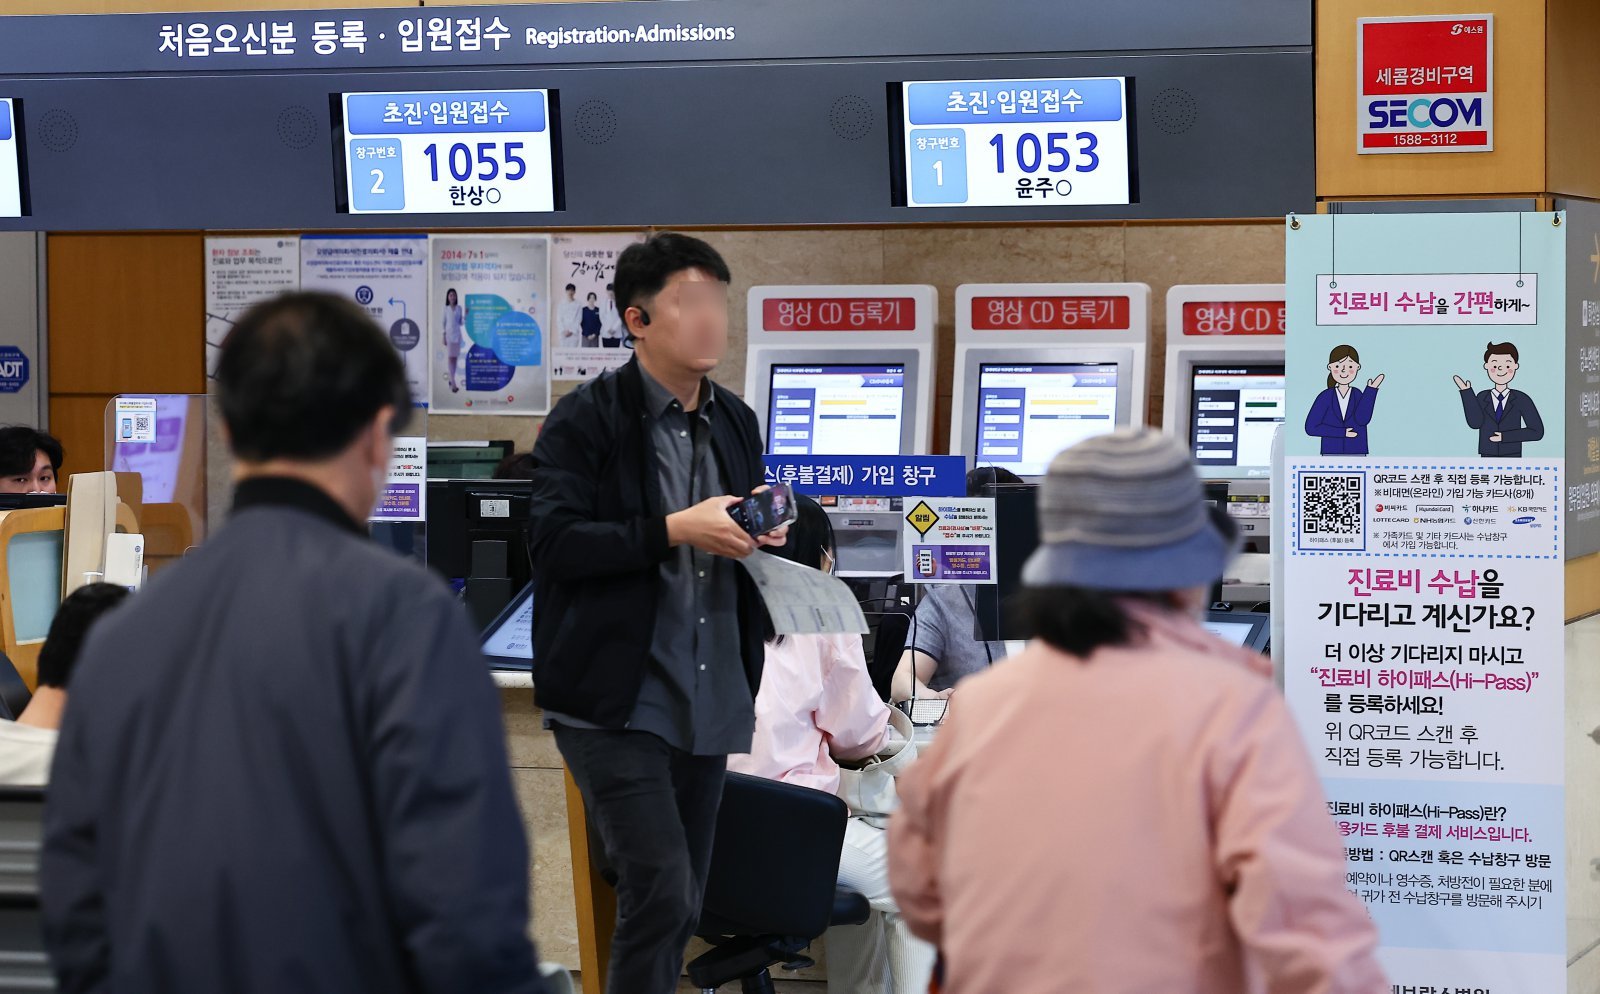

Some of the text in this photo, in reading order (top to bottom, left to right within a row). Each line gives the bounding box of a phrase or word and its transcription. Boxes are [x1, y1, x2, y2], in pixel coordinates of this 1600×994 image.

[158, 22, 297, 57] 처음오신분
[311, 20, 368, 55] 등록
[398, 16, 512, 53] 입원접수
[1375, 65, 1474, 86] 세콤경비구역
[383, 99, 510, 126] 초진·입원접수
[946, 88, 1084, 115] 초진·입원접수
[1368, 97, 1482, 129] SECOM
[915, 136, 961, 150] 창구번호
[1393, 133, 1458, 145] 1588-3112
[355, 145, 397, 160] 창구번호
[424, 141, 527, 182] 1055
[989, 131, 1100, 174] 1053
[369, 168, 385, 194] 2
[931, 159, 944, 187] 1
[777, 301, 901, 326] 영상 CD 등록기
[987, 300, 1115, 325] 영상 CD 등록기
[1329, 291, 1530, 316] 진료비 수납을 간편하게~
[1195, 307, 1236, 333] 영상
[1240, 308, 1271, 331] CD
[861, 464, 895, 485] 가입
[902, 464, 937, 486] 창구
[1373, 474, 1545, 486] QR코드 스캔 후 직접 등록 가능합니다.
[1446, 488, 1464, 499] 가입
[1466, 488, 1484, 499] 가능
[1485, 488, 1534, 500] 카드사(8개)
[915, 514, 930, 522] 알림
[1382, 540, 1459, 550] 에서 가입 가능합니다.
[1416, 531, 1424, 541] 및
[1426, 531, 1441, 540] 기타
[1444, 531, 1474, 541] 카드사는
[1476, 532, 1507, 541] 수납창구
[1348, 568, 1504, 599] 진료비 수납을
[1318, 601, 1536, 633] 기다리고 계신가요?
[1325, 643, 1525, 666] 더 이상 기다리지 마시고
[1324, 693, 1443, 716] 를 등록하세요!
[1325, 721, 1479, 745] 위 QR코드 스캔 후
[1325, 746, 1505, 771] 직접 등록 가능합니다.
[1335, 820, 1533, 843] 용카드 후불 결제 서비스입니다.
[1344, 847, 1374, 862] 방법
[1388, 849, 1433, 865] QR스캔
[1438, 851, 1464, 866] 혹은
[1468, 852, 1521, 868] 수납창구
[1525, 853, 1552, 869] 방문
[1437, 875, 1485, 890] 처방전이
[1489, 876, 1525, 892] 필요한
[1528, 877, 1553, 893] 분에
[1361, 889, 1386, 904] 귀가
[1388, 890, 1400, 904] 전
[1403, 891, 1463, 907] 수납창구를
[1466, 893, 1503, 909] 방문해
[1505, 894, 1542, 910] 주시기
